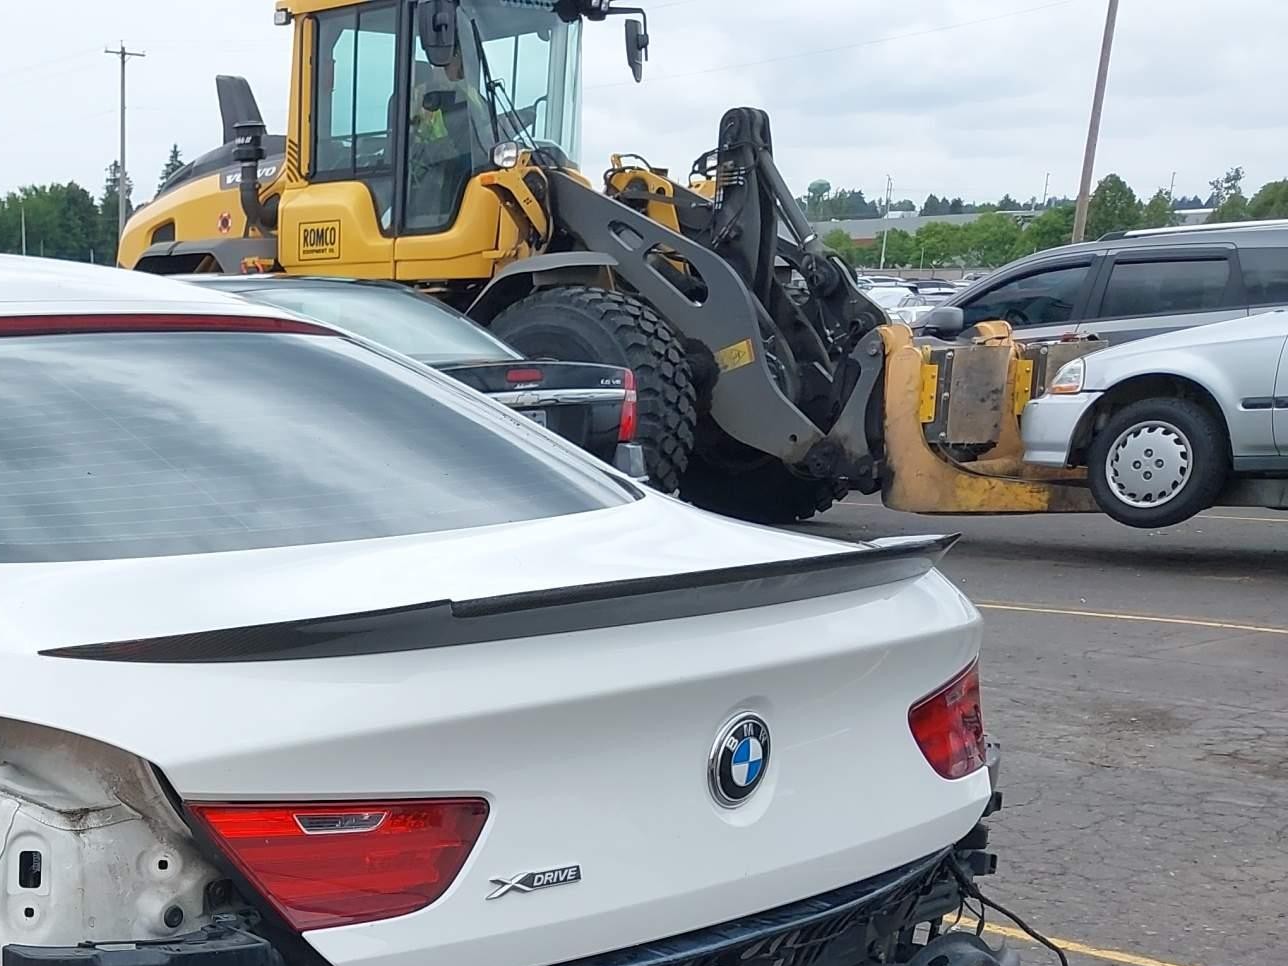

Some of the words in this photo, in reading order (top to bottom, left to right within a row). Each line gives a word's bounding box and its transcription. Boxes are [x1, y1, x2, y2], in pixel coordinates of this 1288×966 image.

[226, 166, 277, 184] VOVO
[303, 226, 337, 248] ROMCO
[725, 723, 769, 752] BMW
